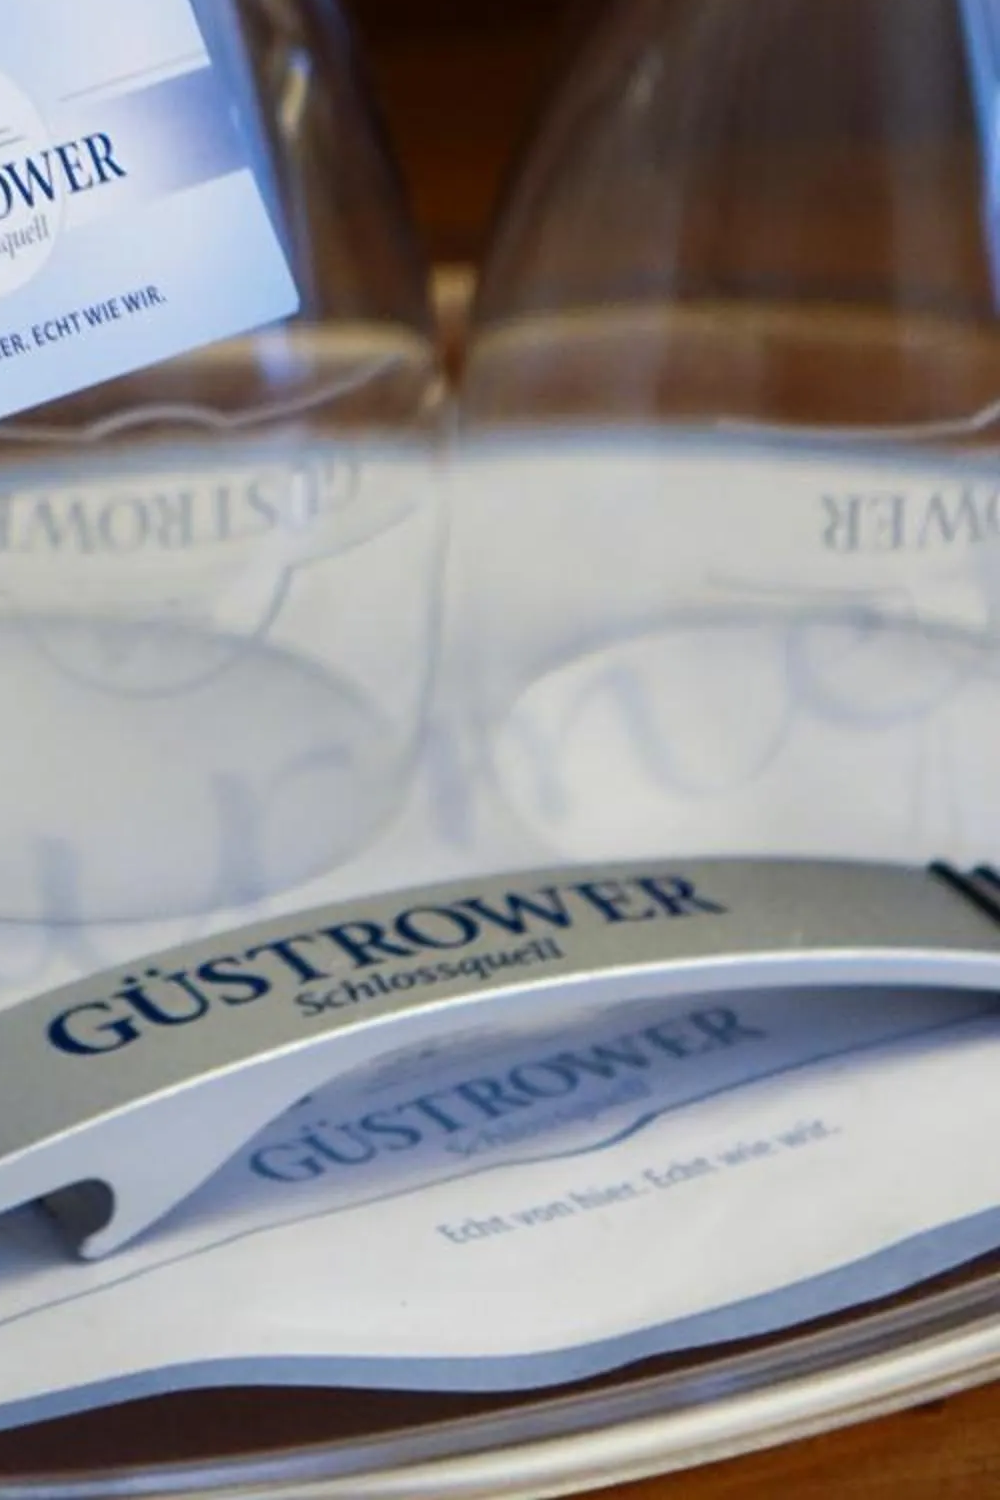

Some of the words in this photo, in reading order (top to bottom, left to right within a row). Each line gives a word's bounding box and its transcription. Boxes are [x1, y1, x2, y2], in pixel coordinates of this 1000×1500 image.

[31, 311, 81, 347] ECHT
[82, 297, 120, 328] WIE
[122, 284, 167, 313] WIR.
[46, 871, 729, 1056] GÜSTROWER
[295, 937, 564, 1019] Schlossquell
[248, 1004, 768, 1184] GÜSTROWER
[514, 1202, 574, 1228] von
